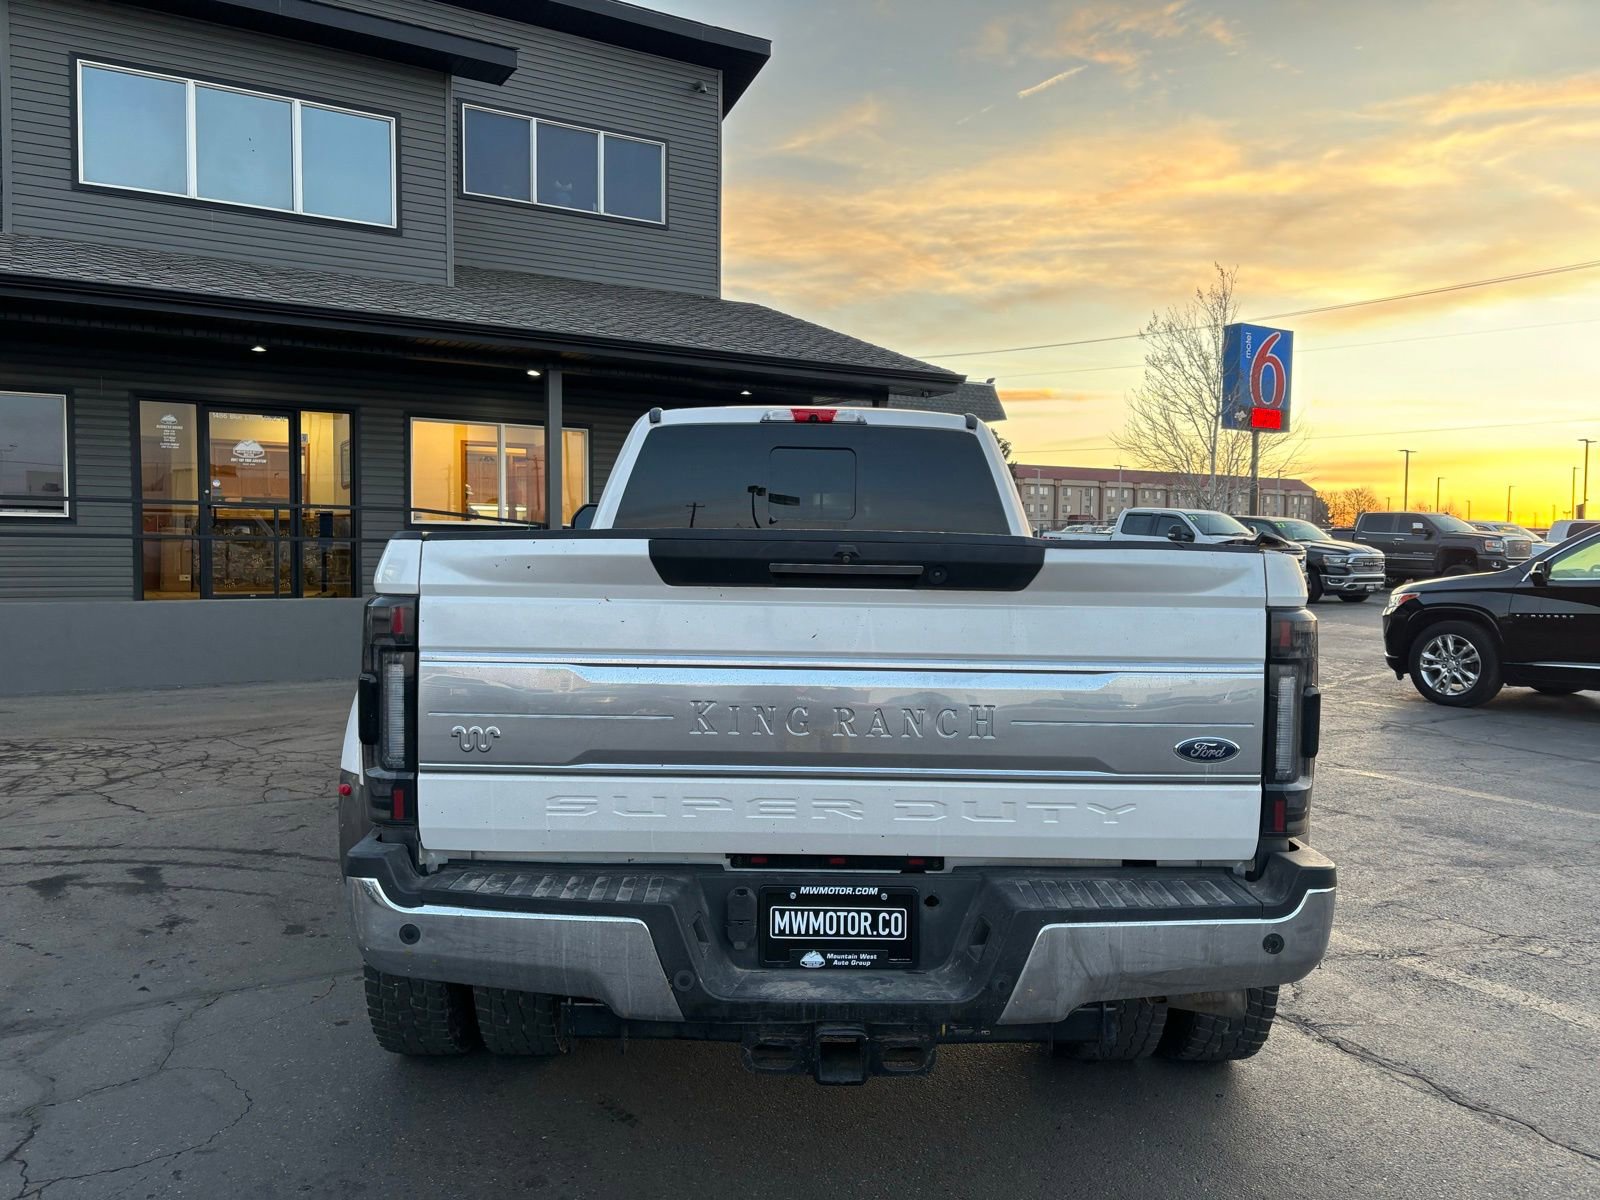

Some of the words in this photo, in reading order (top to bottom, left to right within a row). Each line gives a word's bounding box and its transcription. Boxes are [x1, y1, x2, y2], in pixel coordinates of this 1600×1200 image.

[1249, 331, 1287, 408] 6
[689, 700, 810, 738] KING
[832, 704, 997, 740] RANCH
[1190, 742, 1226, 757] Ford
[545, 794, 864, 821] SUPER
[893, 799, 1137, 824] DUTY
[799, 886, 879, 896] MWMOTOR.COM
[774, 910, 903, 936] MWMOTOR.CO
